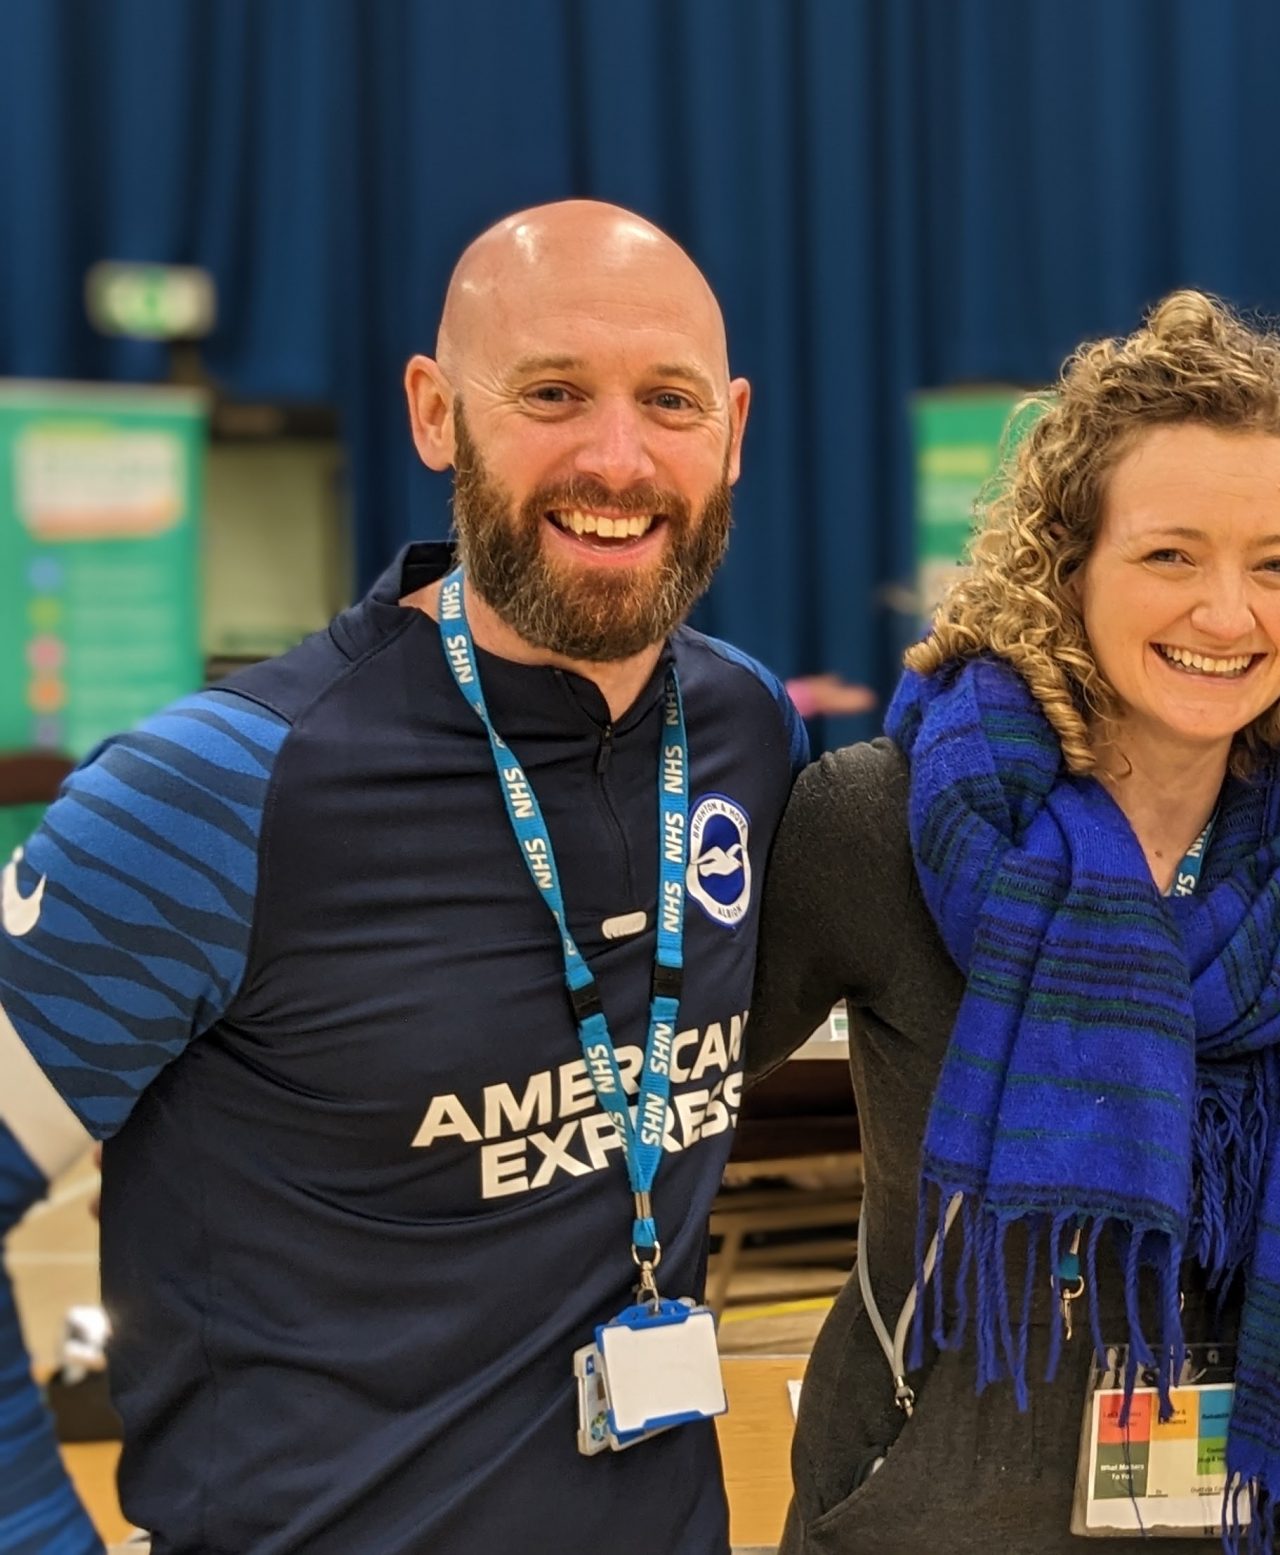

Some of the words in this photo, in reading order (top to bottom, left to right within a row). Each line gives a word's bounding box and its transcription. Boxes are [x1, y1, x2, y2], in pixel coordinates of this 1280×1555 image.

[442, 581, 462, 619] NHS
[447, 634, 474, 684] NHS
[504, 767, 535, 819] NHS
[664, 745, 683, 794] NHS
[665, 812, 684, 863] NHS
[524, 838, 553, 889] NHS
[663, 882, 681, 932] NHS
[717, 904, 742, 919] ALBION
[587, 1044, 616, 1094] NHS
[651, 1023, 672, 1076] NHS
[411, 1010, 749, 1147] AMERCAN
[641, 1093, 665, 1147] NHS
